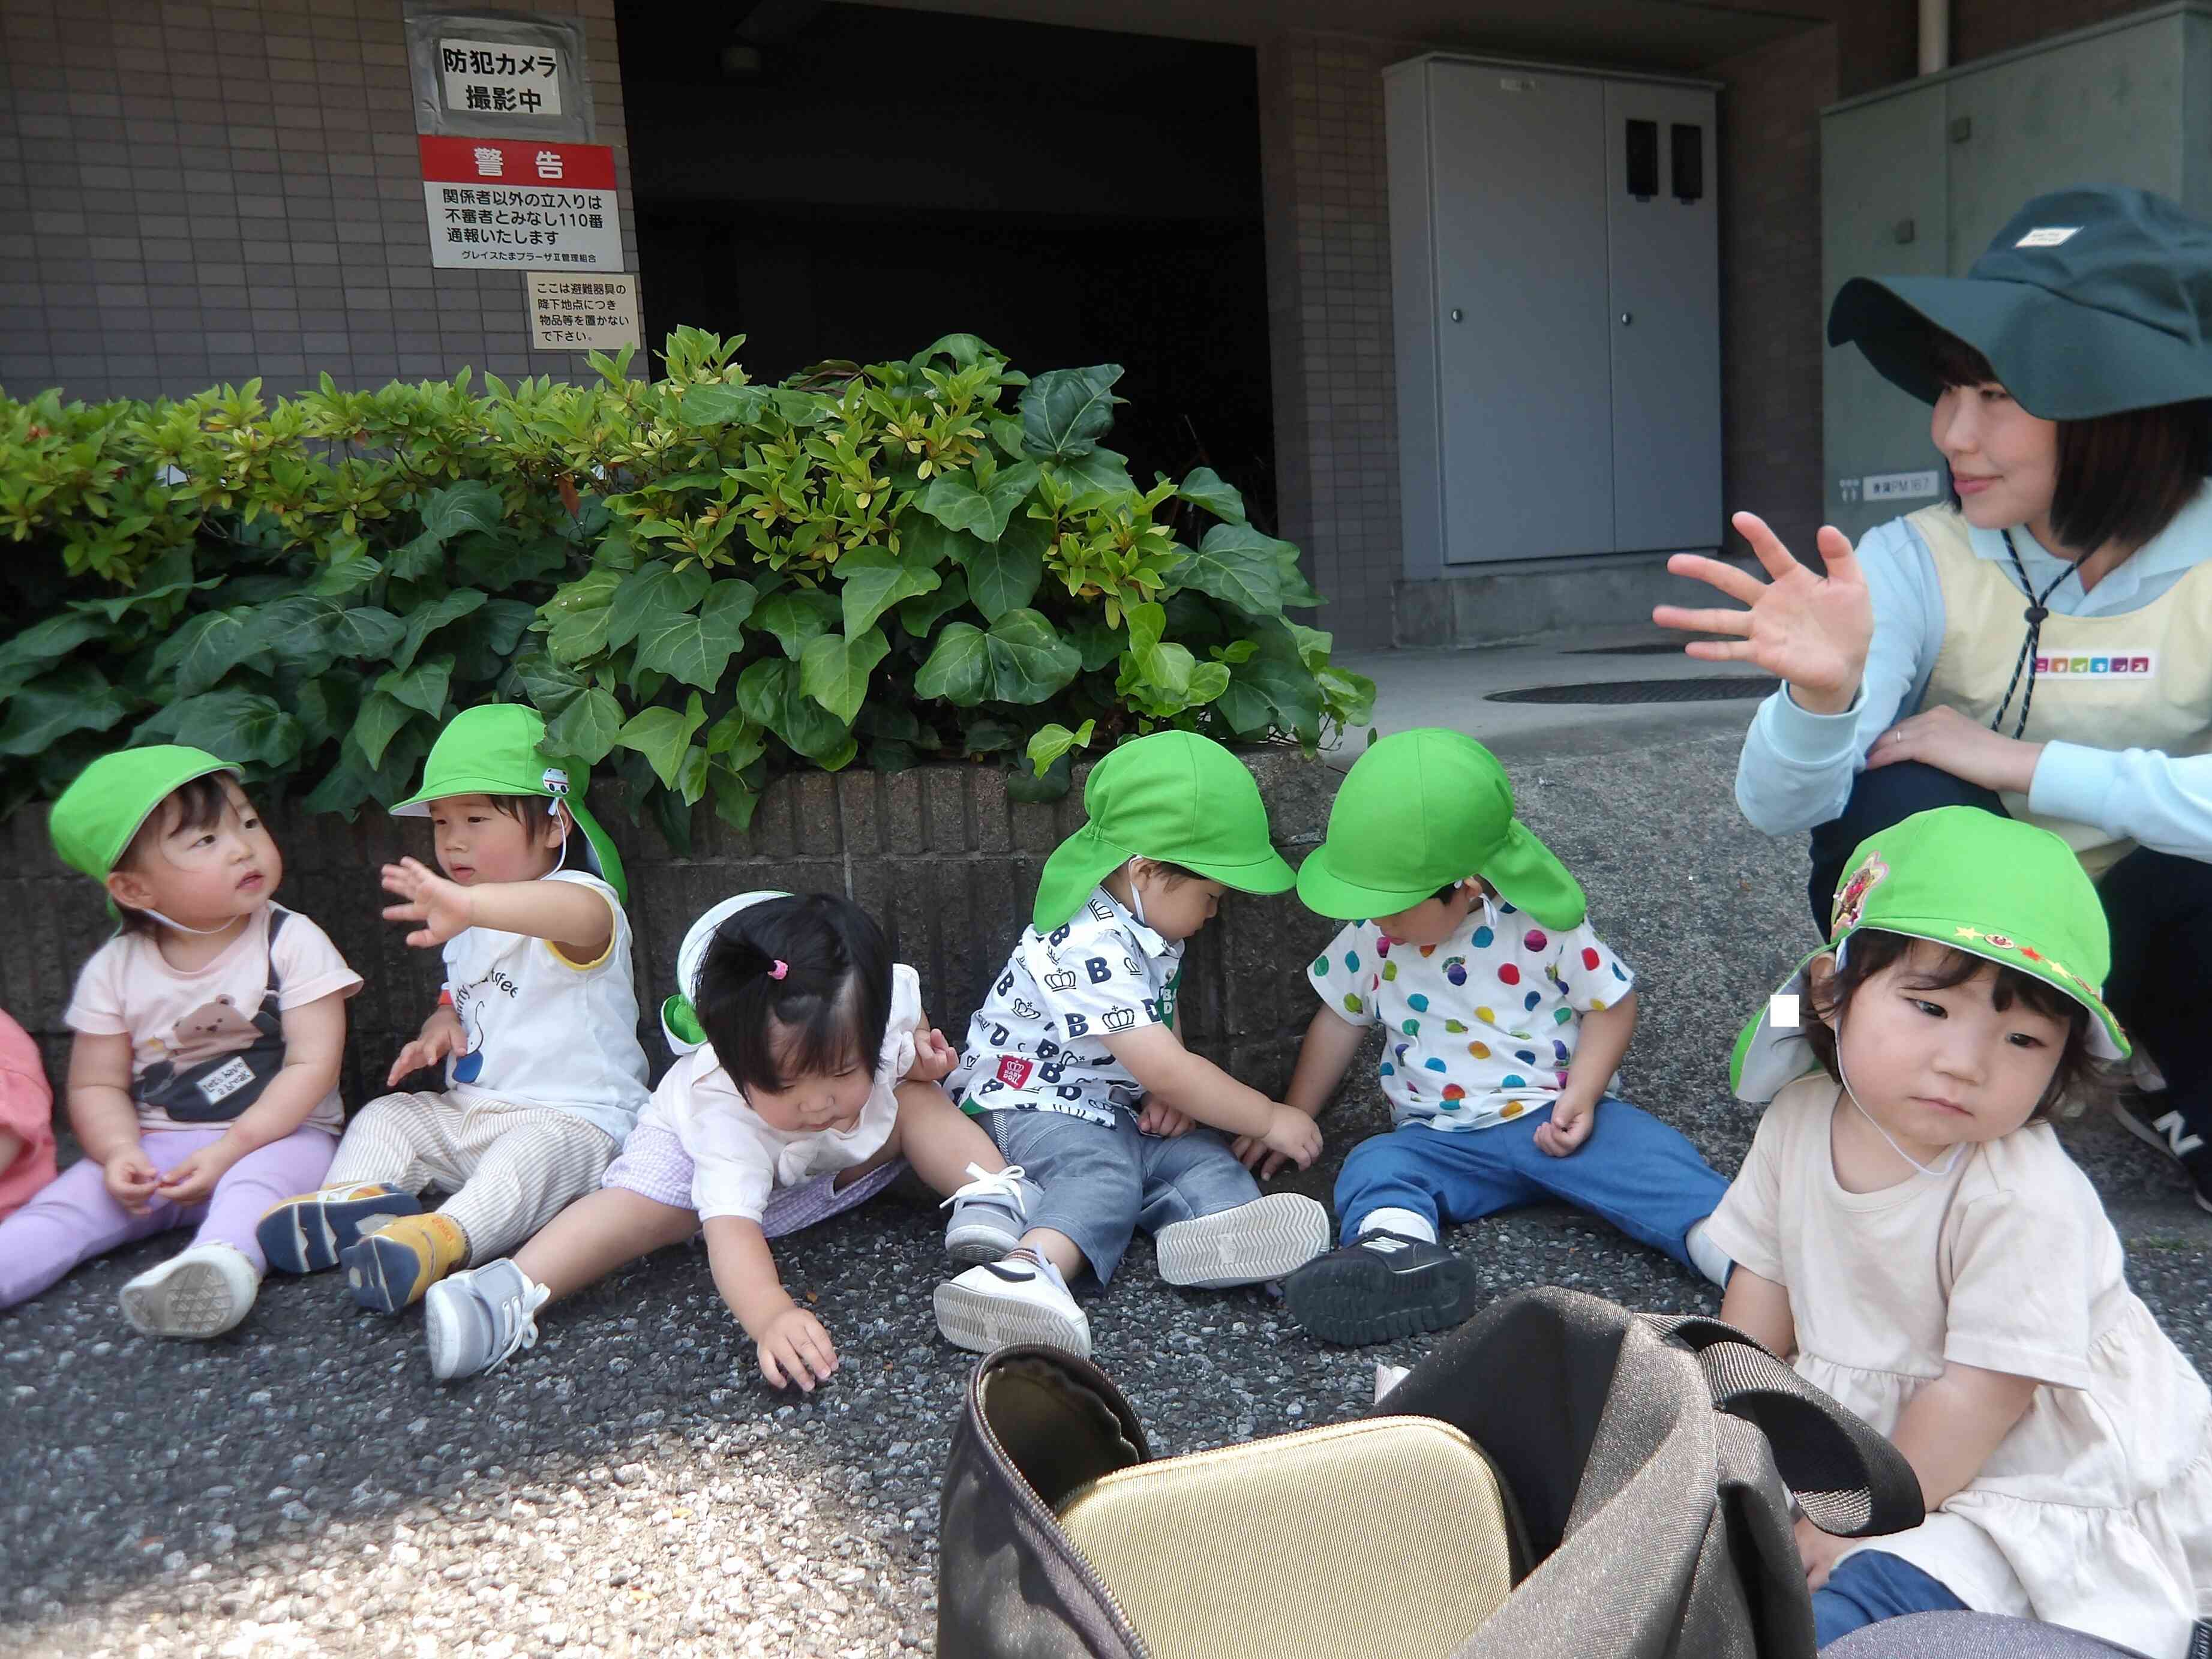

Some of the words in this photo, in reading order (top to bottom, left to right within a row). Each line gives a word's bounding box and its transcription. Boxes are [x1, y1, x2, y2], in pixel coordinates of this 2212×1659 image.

[442, 47, 557, 78] 防犯カメラ
[466, 85, 542, 113] 撮影中
[473, 146, 563, 179] 警告
[443, 188, 603, 210] 関係者以外の立入りは
[445, 208, 604, 229] 不審者とみなし110番
[447, 227, 559, 245] 通報いたします
[537, 283, 626, 295] ここは避難器具の
[538, 299, 617, 311] 降下地点につき
[539, 315, 629, 327] 物品等を置かない
[542, 331, 593, 342] で下さい。
[1085, 956, 1112, 984] B
[997, 970, 1015, 997] B
[1064, 1013, 1089, 1038] B
[1035, 1038, 1060, 1059] B
[1038, 1061, 1066, 1084] B
